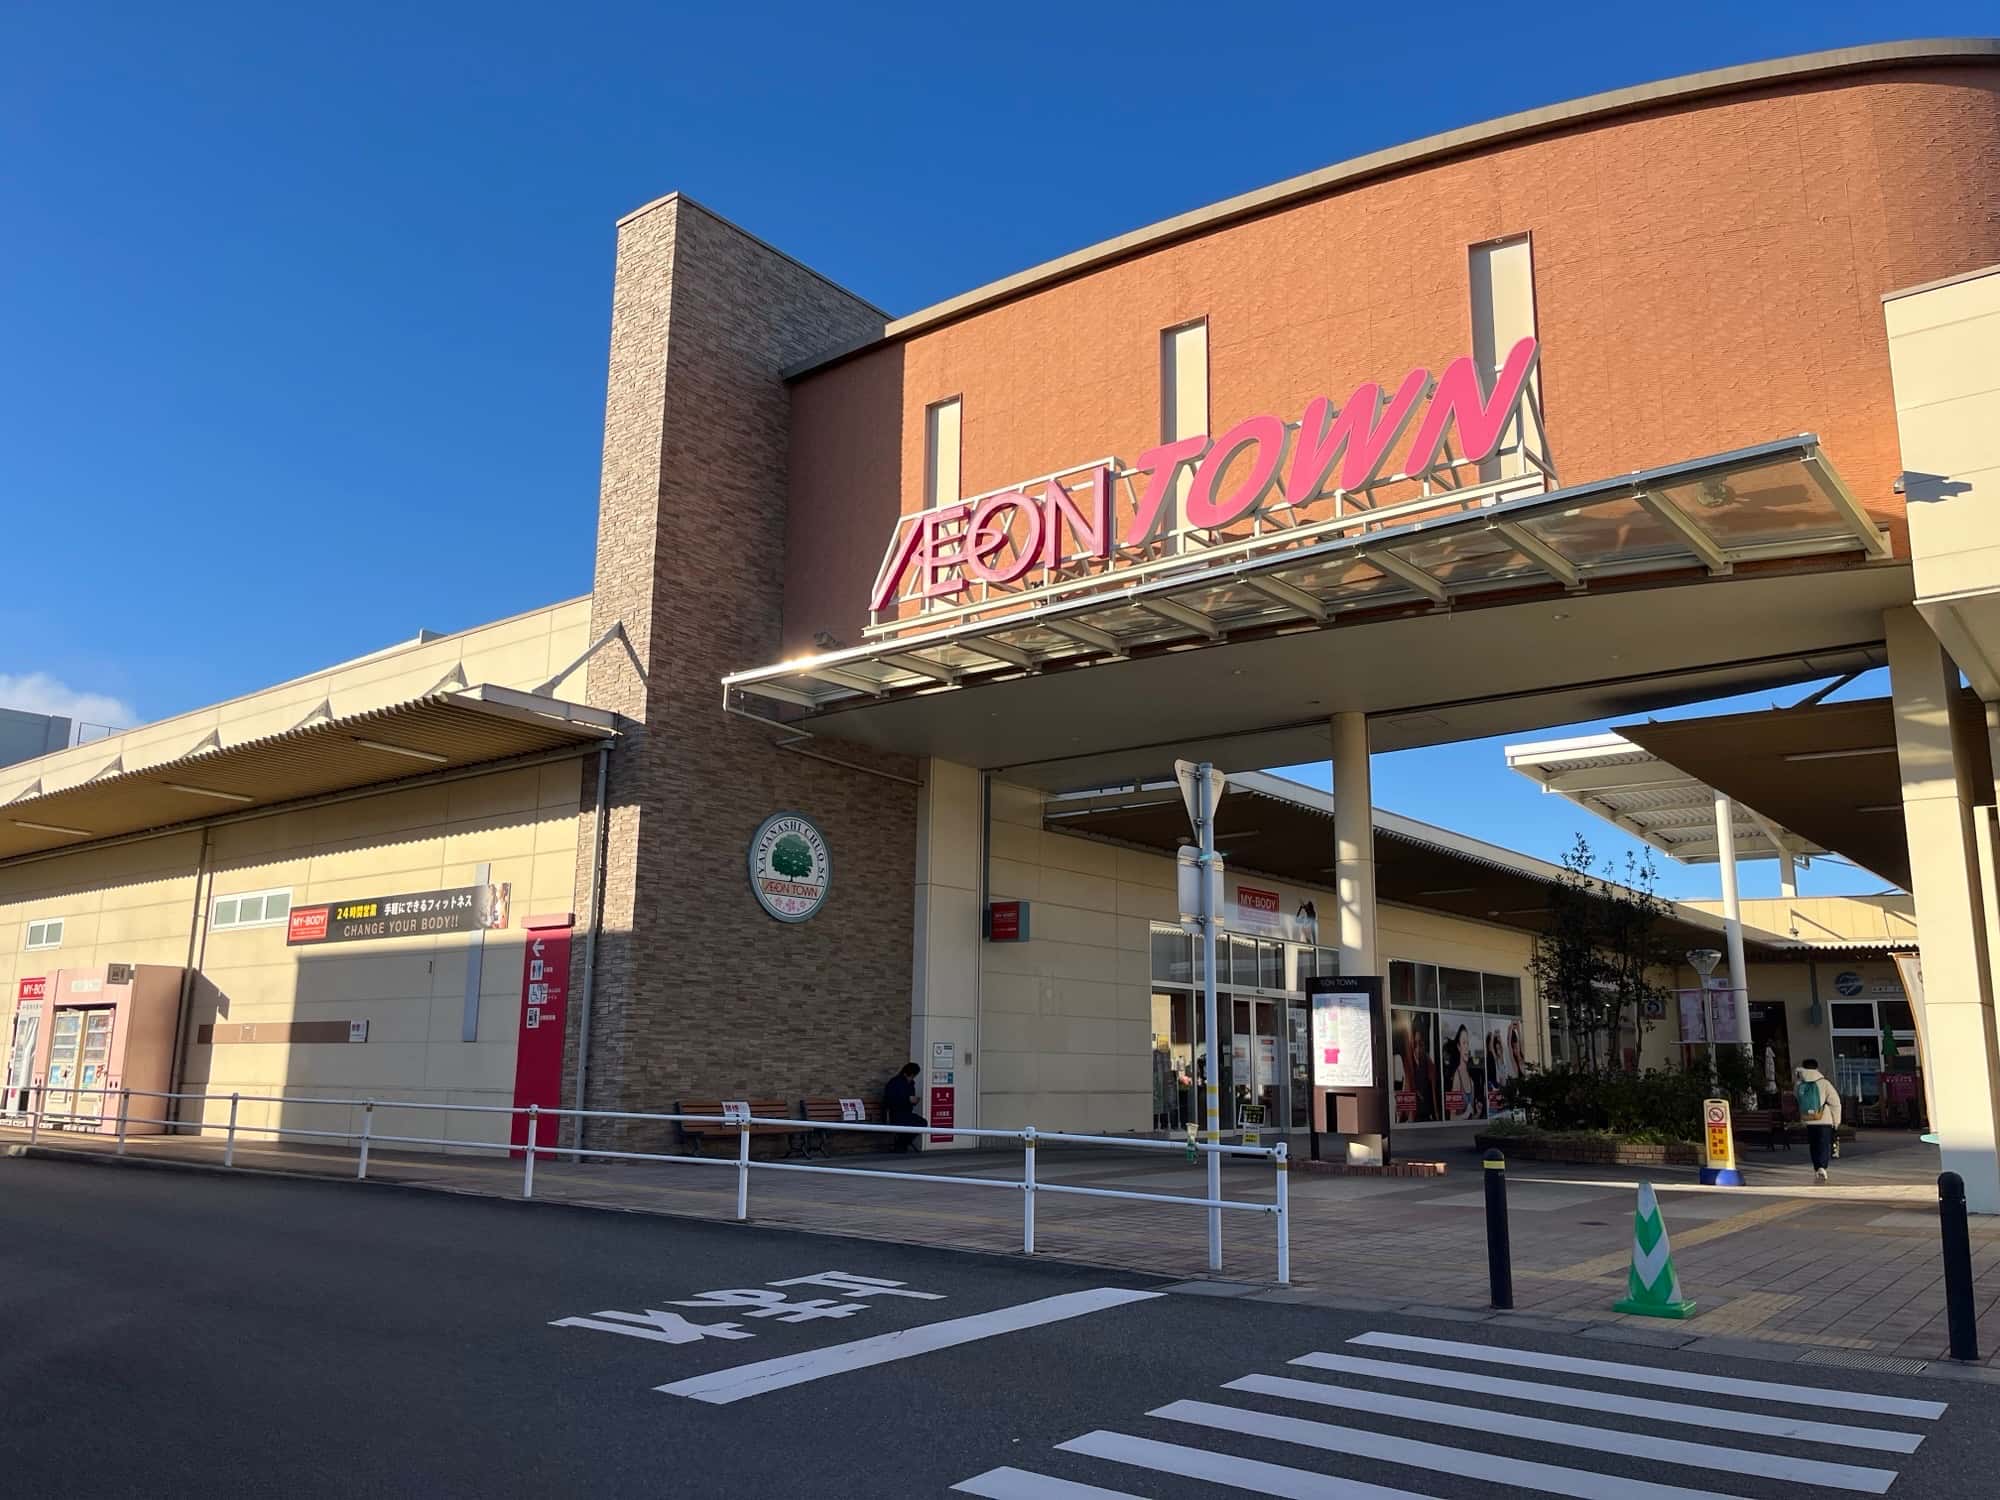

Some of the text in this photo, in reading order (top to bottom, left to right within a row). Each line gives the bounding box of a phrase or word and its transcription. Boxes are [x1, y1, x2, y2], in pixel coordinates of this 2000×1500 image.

[1128, 337, 1540, 546] TOWN
[759, 821, 802, 874] YAMANASHI
[805, 828, 825, 862] CHUO
[792, 884, 818, 897] TOWN
[1240, 893, 1276, 910] MY-BODY
[336, 894, 473, 920] 24時間営業 手軽にできるフィットネス
[292, 914, 326, 928] MY-BODY
[343, 914, 459, 937] CHANGE YOUR BODY!!
[547, 1271, 948, 1344] 止まれ
